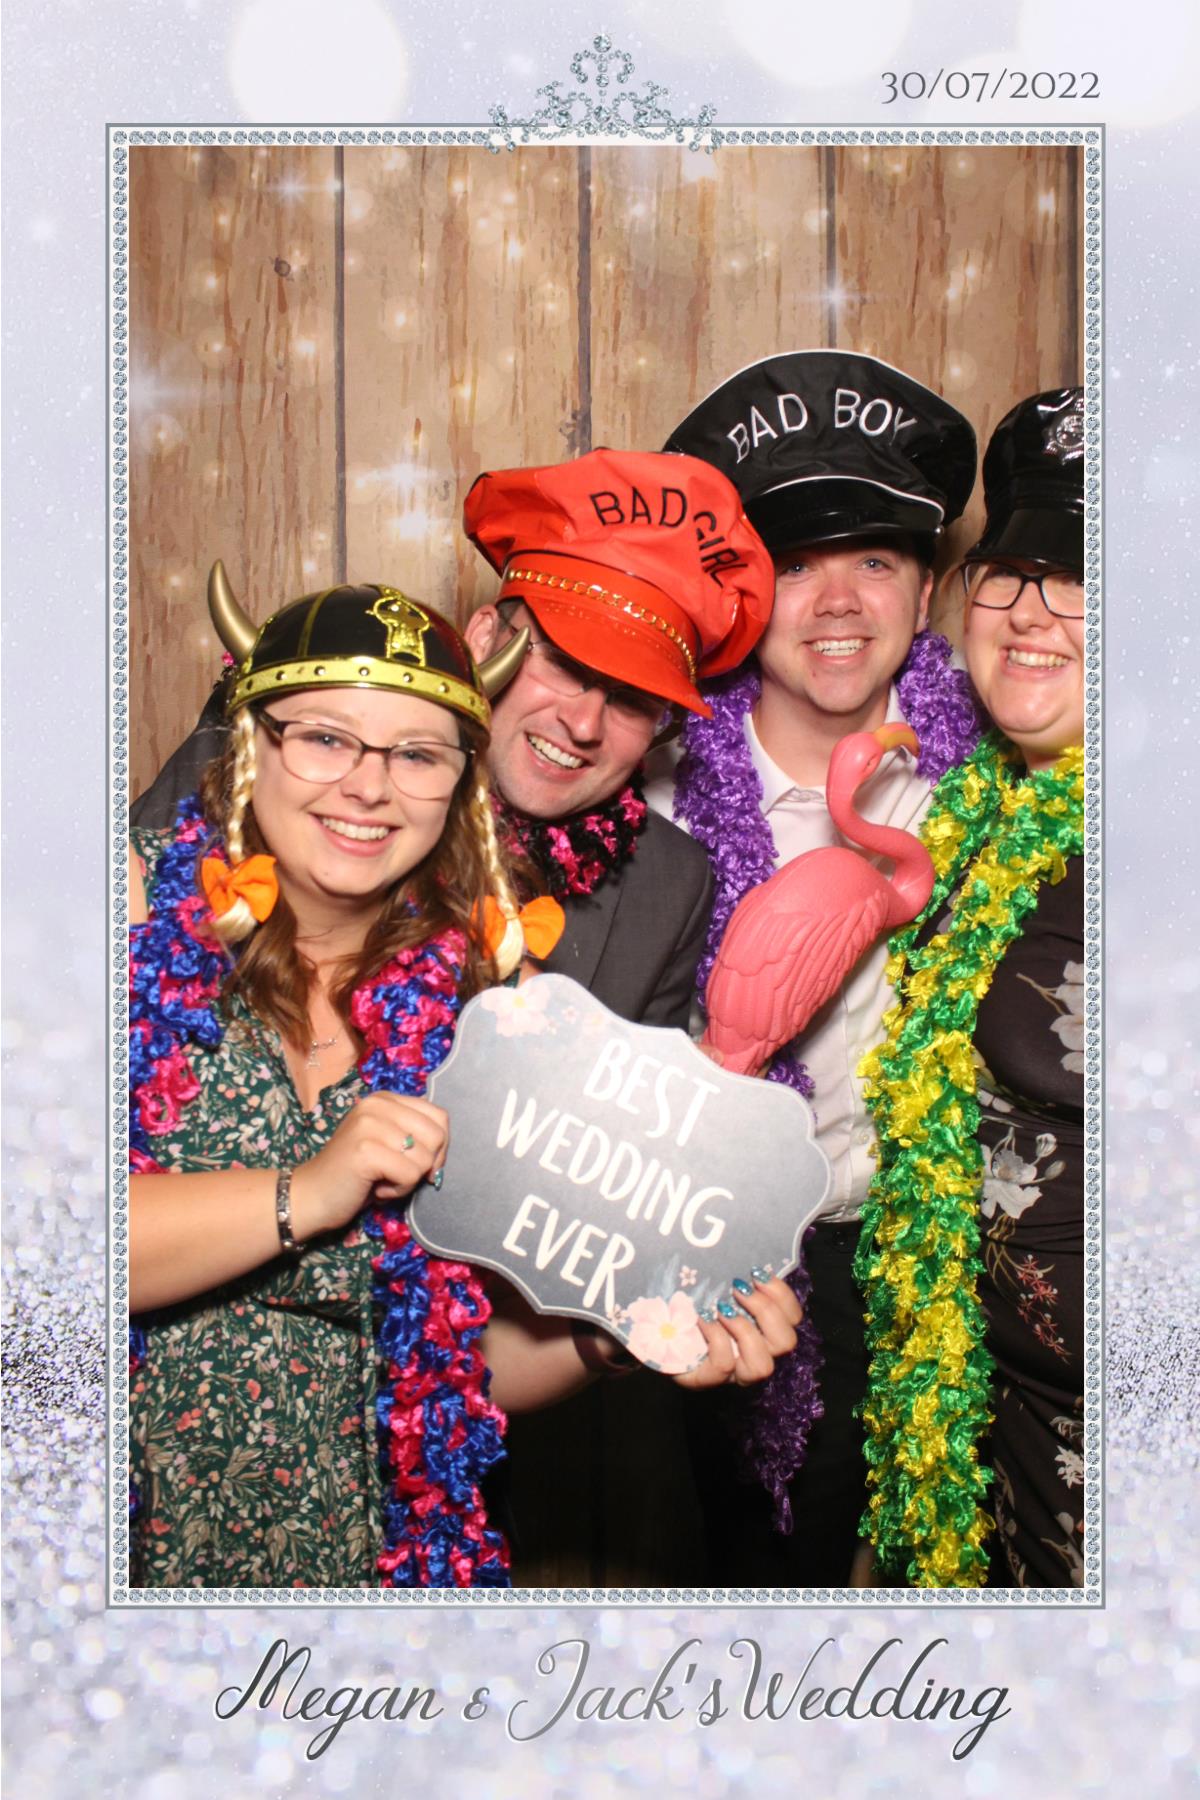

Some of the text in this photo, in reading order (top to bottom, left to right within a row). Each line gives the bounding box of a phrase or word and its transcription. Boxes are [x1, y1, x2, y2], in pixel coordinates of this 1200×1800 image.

[726, 387, 918, 463] BAD BOY
[589, 486, 749, 588] BAD GIRL
[583, 1037, 721, 1146] BEST
[495, 1088, 735, 1248] WEDDING
[502, 1194, 636, 1315] EVER
